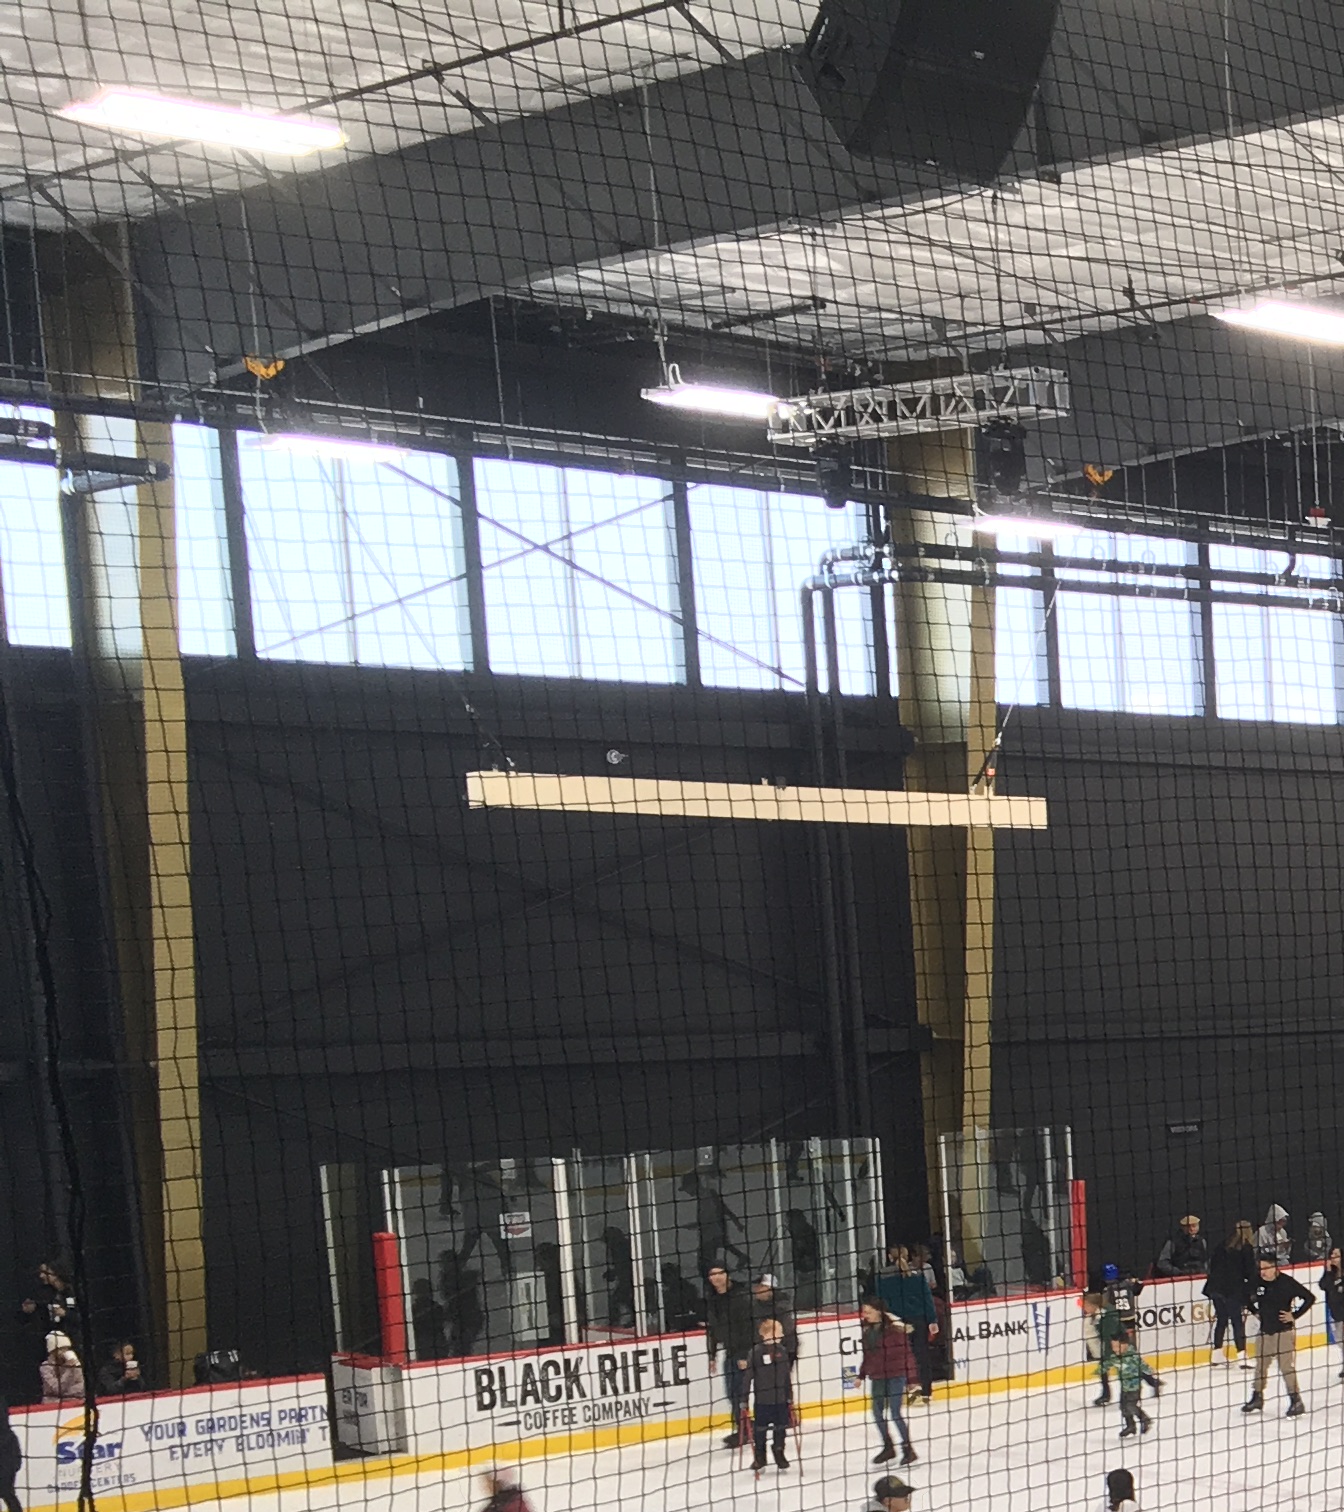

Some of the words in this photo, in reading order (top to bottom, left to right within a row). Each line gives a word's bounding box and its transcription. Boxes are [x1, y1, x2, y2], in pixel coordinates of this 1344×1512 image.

[474, 1356, 588, 1412] BLACK
[597, 1344, 691, 1397] RIFLE
[140, 1421, 188, 1443] YOUR
[194, 1411, 272, 1436] GARDENS
[522, 1405, 579, 1432] COFFEE
[582, 1396, 651, 1423] COMPANY
[169, 1439, 226, 1462] EVERY
